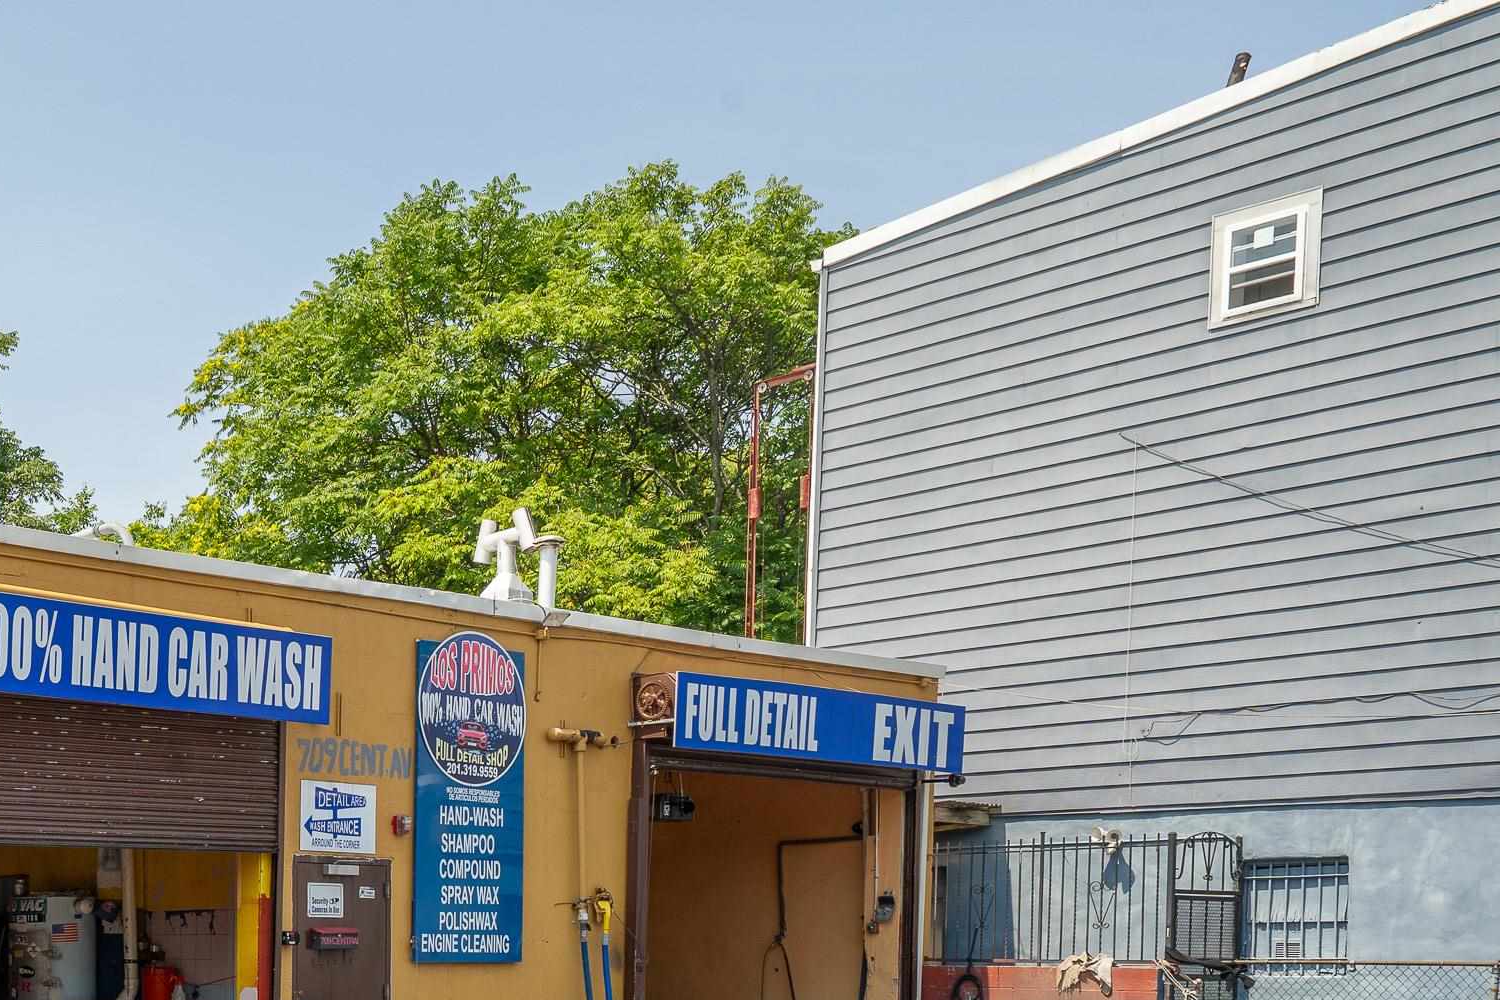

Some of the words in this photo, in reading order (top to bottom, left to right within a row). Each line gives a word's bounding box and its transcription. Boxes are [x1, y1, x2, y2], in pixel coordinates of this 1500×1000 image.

[71, 614, 159, 694] HAND
[167, 627, 229, 701] CAR
[236, 635, 323, 711] WASH
[430, 641, 457, 690] LOS
[460, 640, 515, 696] PRIMOS
[421, 692, 443, 725] 100%
[446, 694, 471, 721] HAND
[474, 698, 494, 726] CAR
[496, 701, 524, 737] WASH
[684, 682, 739, 744] FULL
[744, 688, 818, 752] DETAIL
[871, 702, 955, 769] EXIT
[435, 737, 456, 761] FULL
[457, 748, 485, 765] DETAIL
[486, 744, 509, 768] SHOP
[446, 761, 499, 778] 201.319.9559
[318, 791, 350, 807] DETAIL
[439, 804, 504, 828] HAND-WASH
[327, 820, 360, 835] ENTRANCE
[334, 838, 343, 849] THE
[343, 840, 361, 849] CORNER
[440, 832, 495, 855] SHAMPOO
[439, 859, 501, 880] COMPOUND
[440, 885, 475, 905] SPRAY
[476, 886, 500, 905] WAX
[439, 911, 498, 931] POLISHWAX
[421, 933, 459, 953] ENGINE
[460, 934, 510, 954] CLEANING
